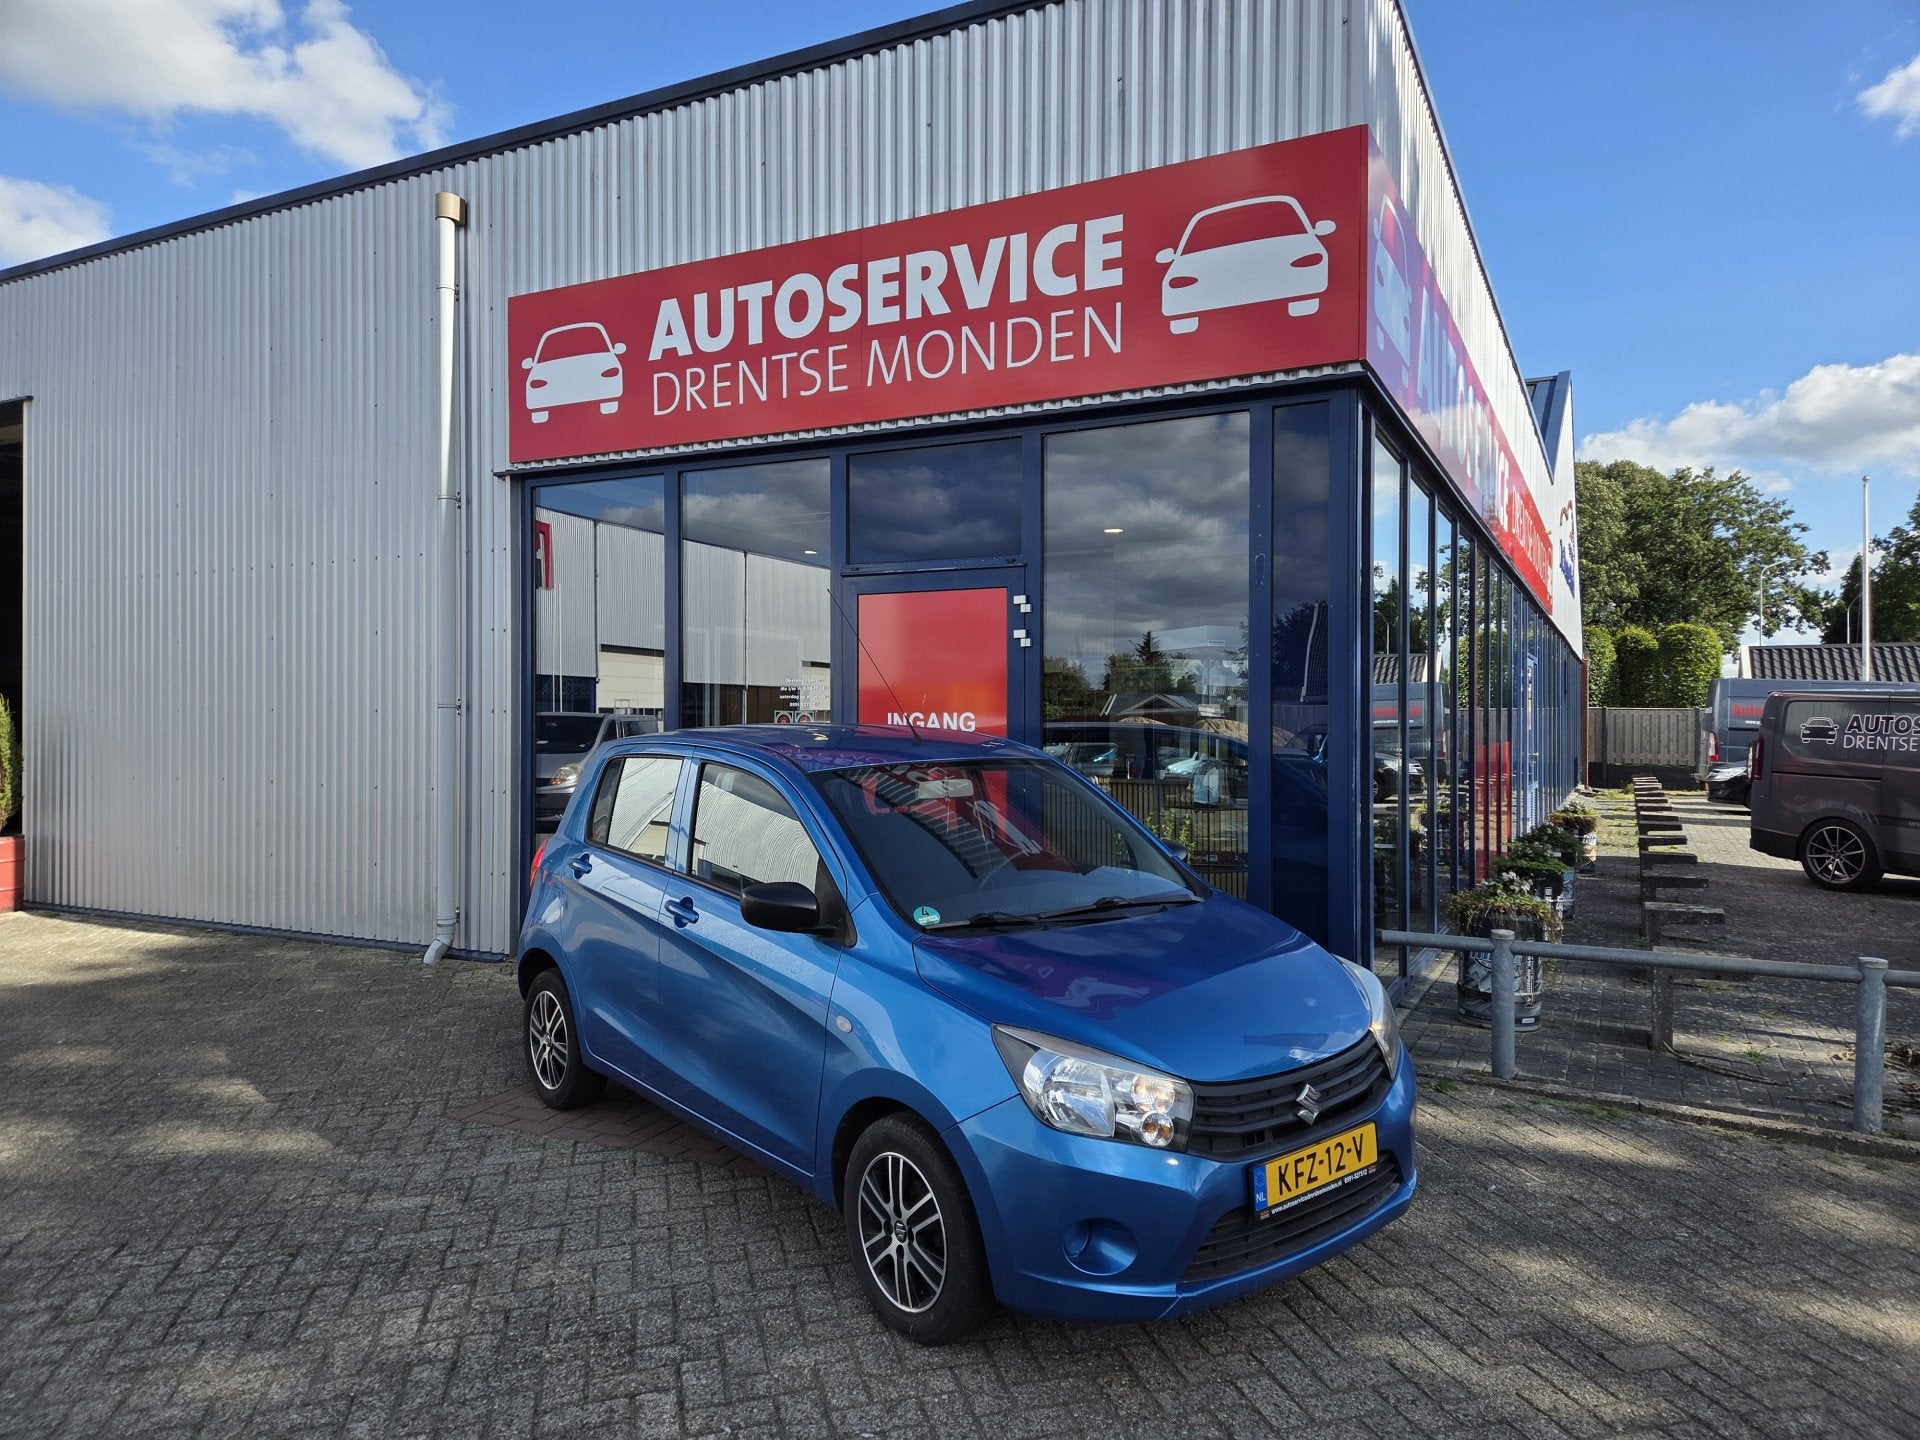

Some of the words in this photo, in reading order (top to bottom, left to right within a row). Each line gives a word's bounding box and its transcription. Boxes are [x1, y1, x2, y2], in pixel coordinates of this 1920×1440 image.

[648, 213, 1124, 362] AUTOSERVICE
[652, 344, 849, 417] DRENTSE
[866, 301, 1123, 387] MONDEN
[887, 712, 976, 732] INGANG
[1843, 734, 1918, 751] DRENTSE
[1278, 1133, 1364, 1196] KFZ-12-V
[1256, 1191, 1267, 1204] NL
